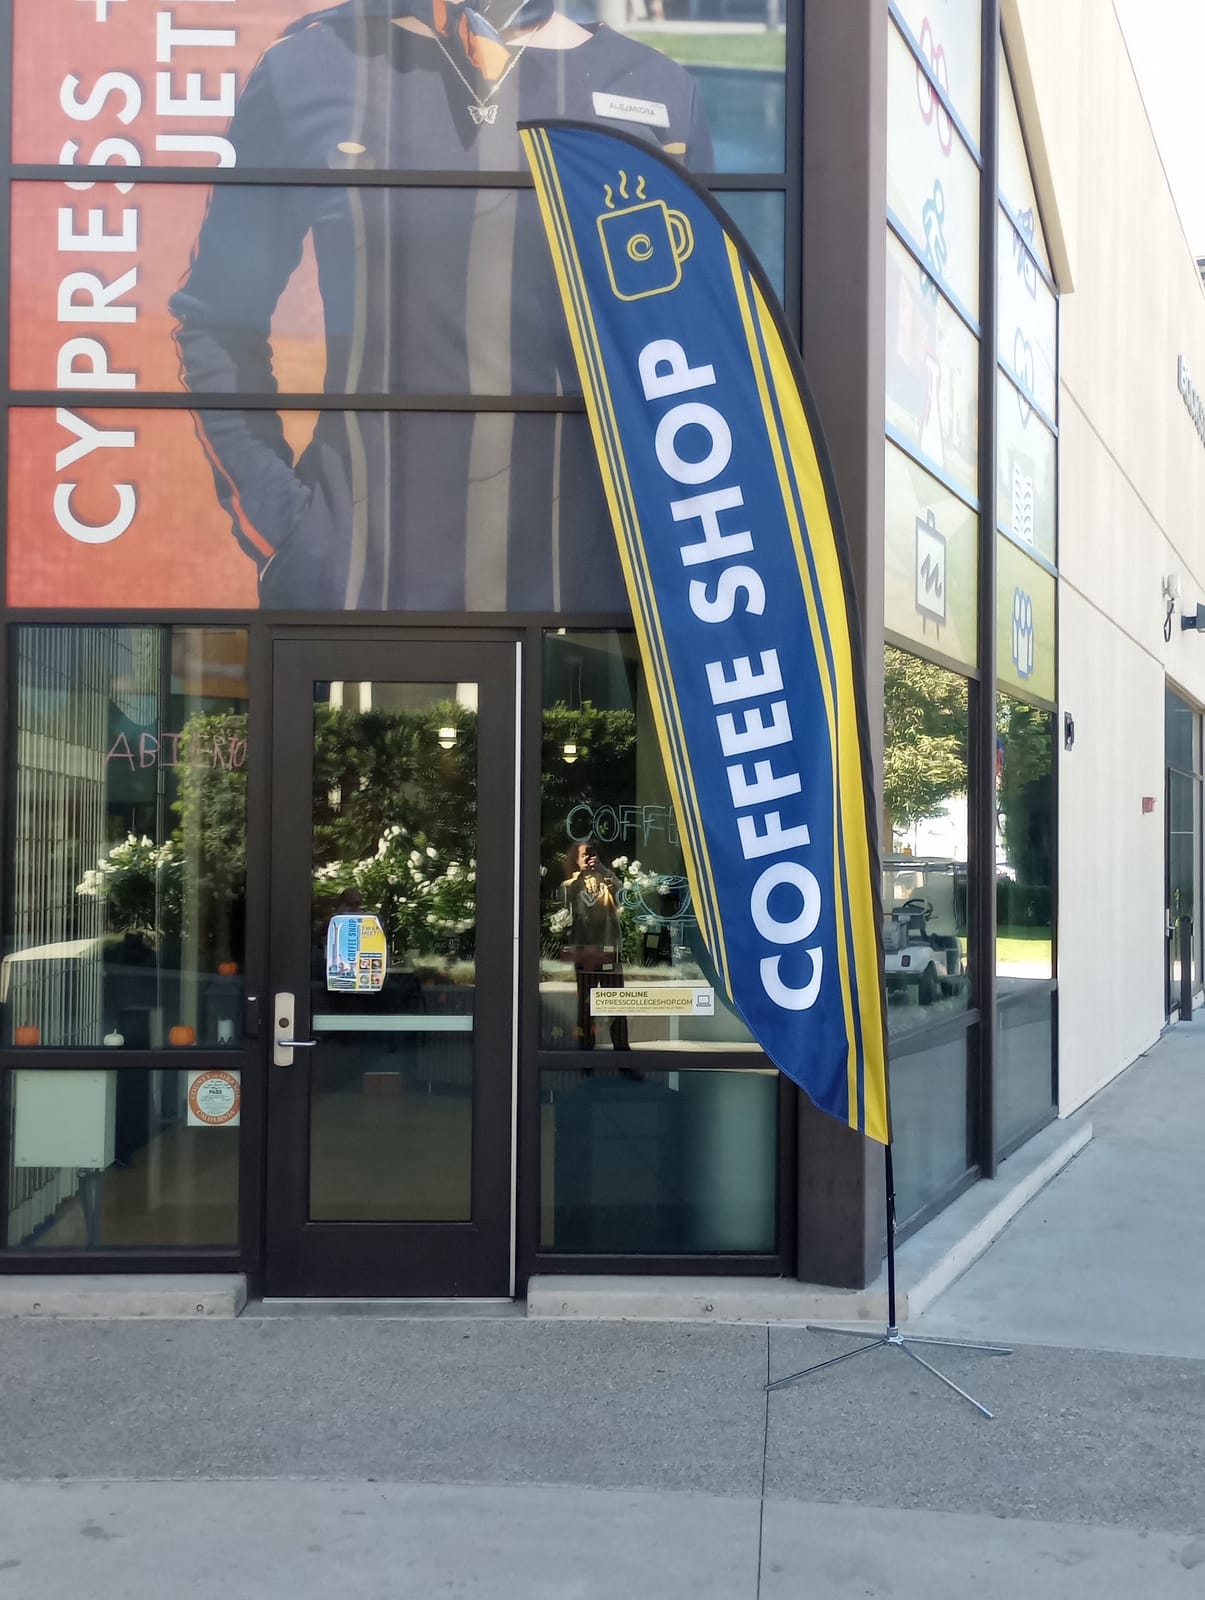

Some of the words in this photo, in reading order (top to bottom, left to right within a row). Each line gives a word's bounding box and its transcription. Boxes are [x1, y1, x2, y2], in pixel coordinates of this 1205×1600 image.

[156, 0, 237, 168] JET
[610, 102, 655, 116] ALEJANDRA
[54, 71, 142, 544] CYPRESS
[638, 339, 766, 624] SHOP
[102, 731, 249, 772] ABIERTO
[705, 648, 823, 1010] COFFEE
[348, 918, 357, 937] SHOP
